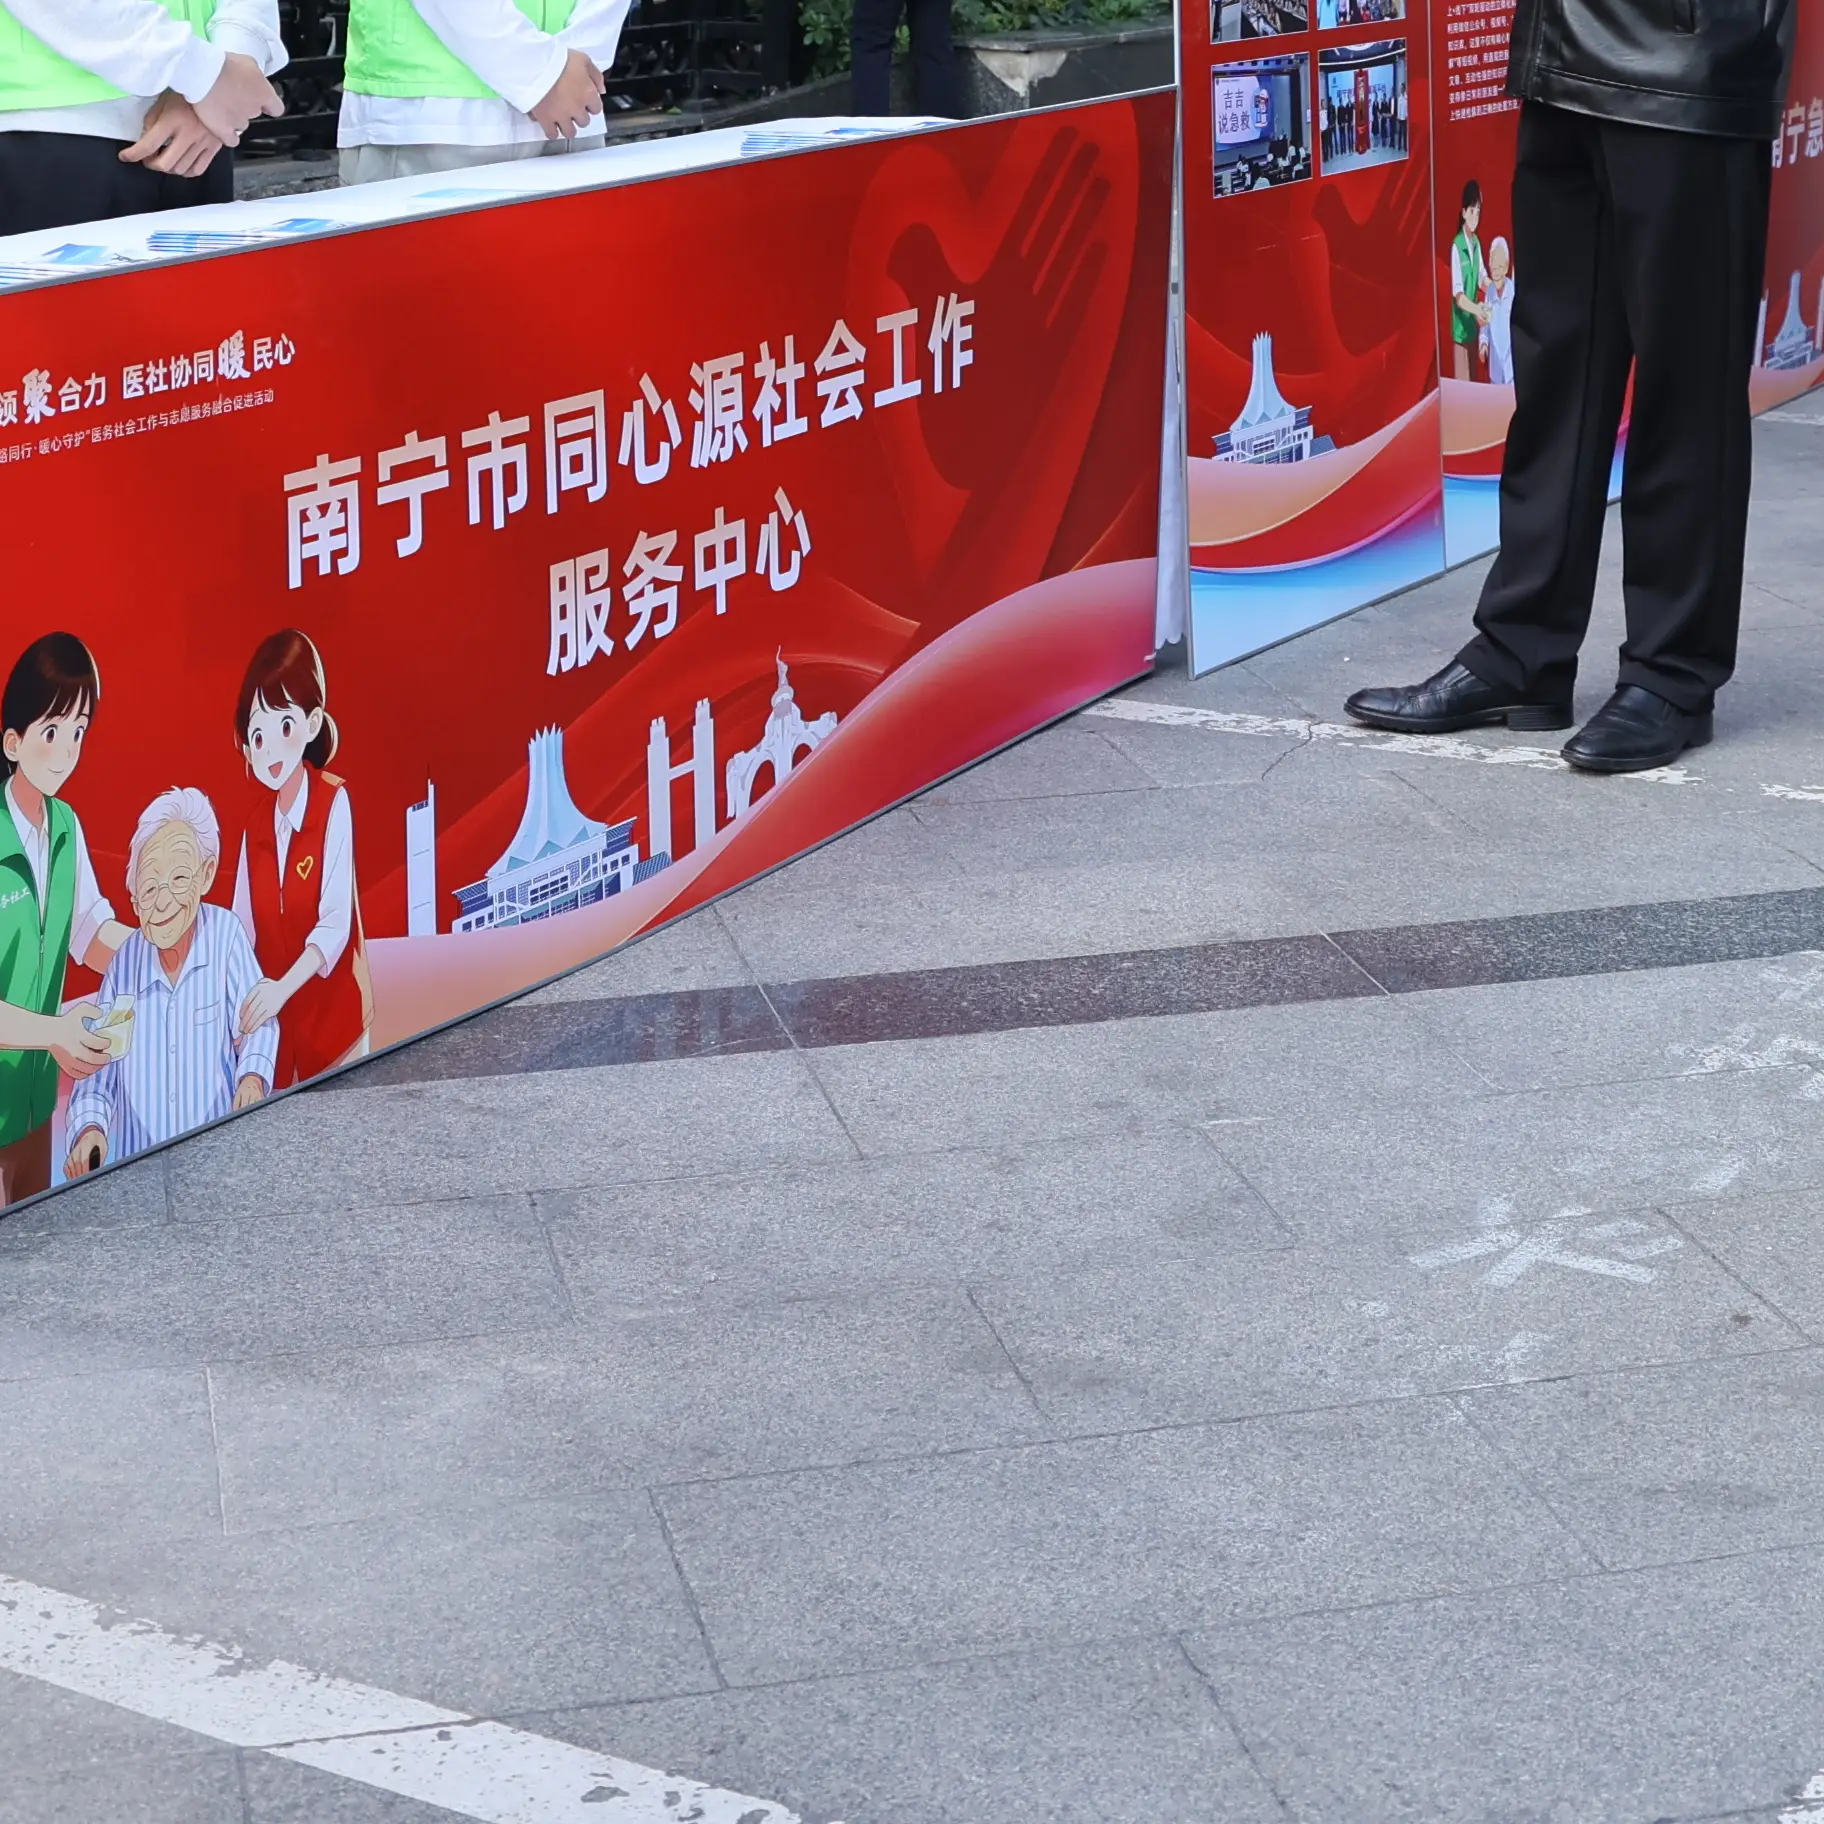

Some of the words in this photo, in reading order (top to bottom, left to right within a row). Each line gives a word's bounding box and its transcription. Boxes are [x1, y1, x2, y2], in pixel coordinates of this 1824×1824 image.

[122, 330, 295, 400] 医社协同暖民心
[283, 292, 975, 590] 南宁市同心源社会工作
[546, 487, 811, 676] 服务中心
